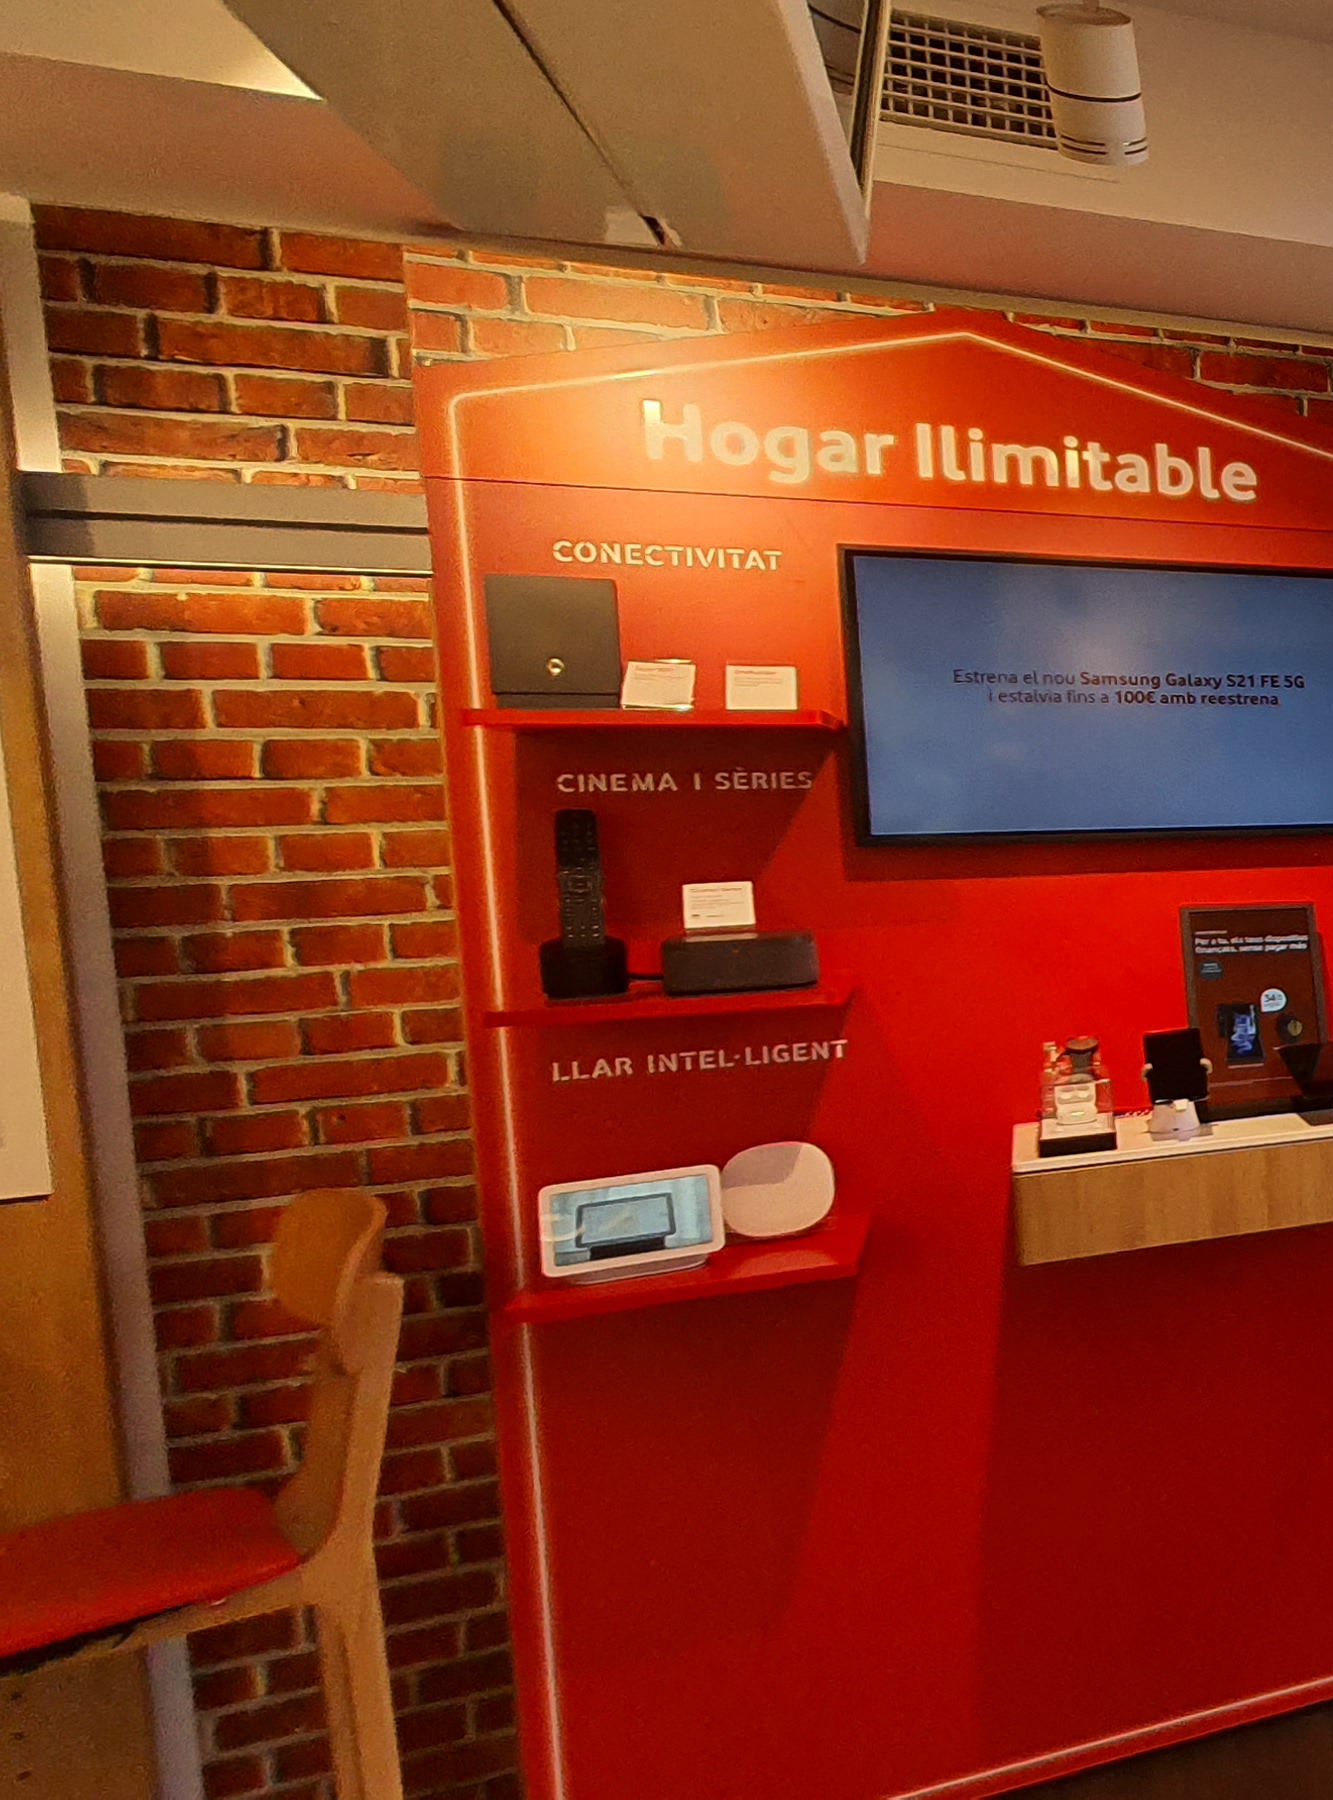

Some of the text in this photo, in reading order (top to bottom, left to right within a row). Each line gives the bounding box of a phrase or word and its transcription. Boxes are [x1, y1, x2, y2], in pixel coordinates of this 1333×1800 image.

[643, 399, 1258, 501] Hogar Ilimitable
[552, 540, 783, 571] CONECTIVITAT
[953, 669, 1305, 690] Estrena el nou Samsung Galaxy S21 FE 5G
[998, 689, 1063, 703] estalvia
[1067, 690, 1096, 704] fins
[1100, 693, 1110, 704] a
[1114, 690, 1156, 705] 100€
[1160, 690, 1197, 705] amb
[1200, 692, 1280, 707] reestrena
[556, 767, 813, 793] CINEMA I SÈRIES
[551, 1039, 848, 1082] LLAR INTEL·LIGENT
